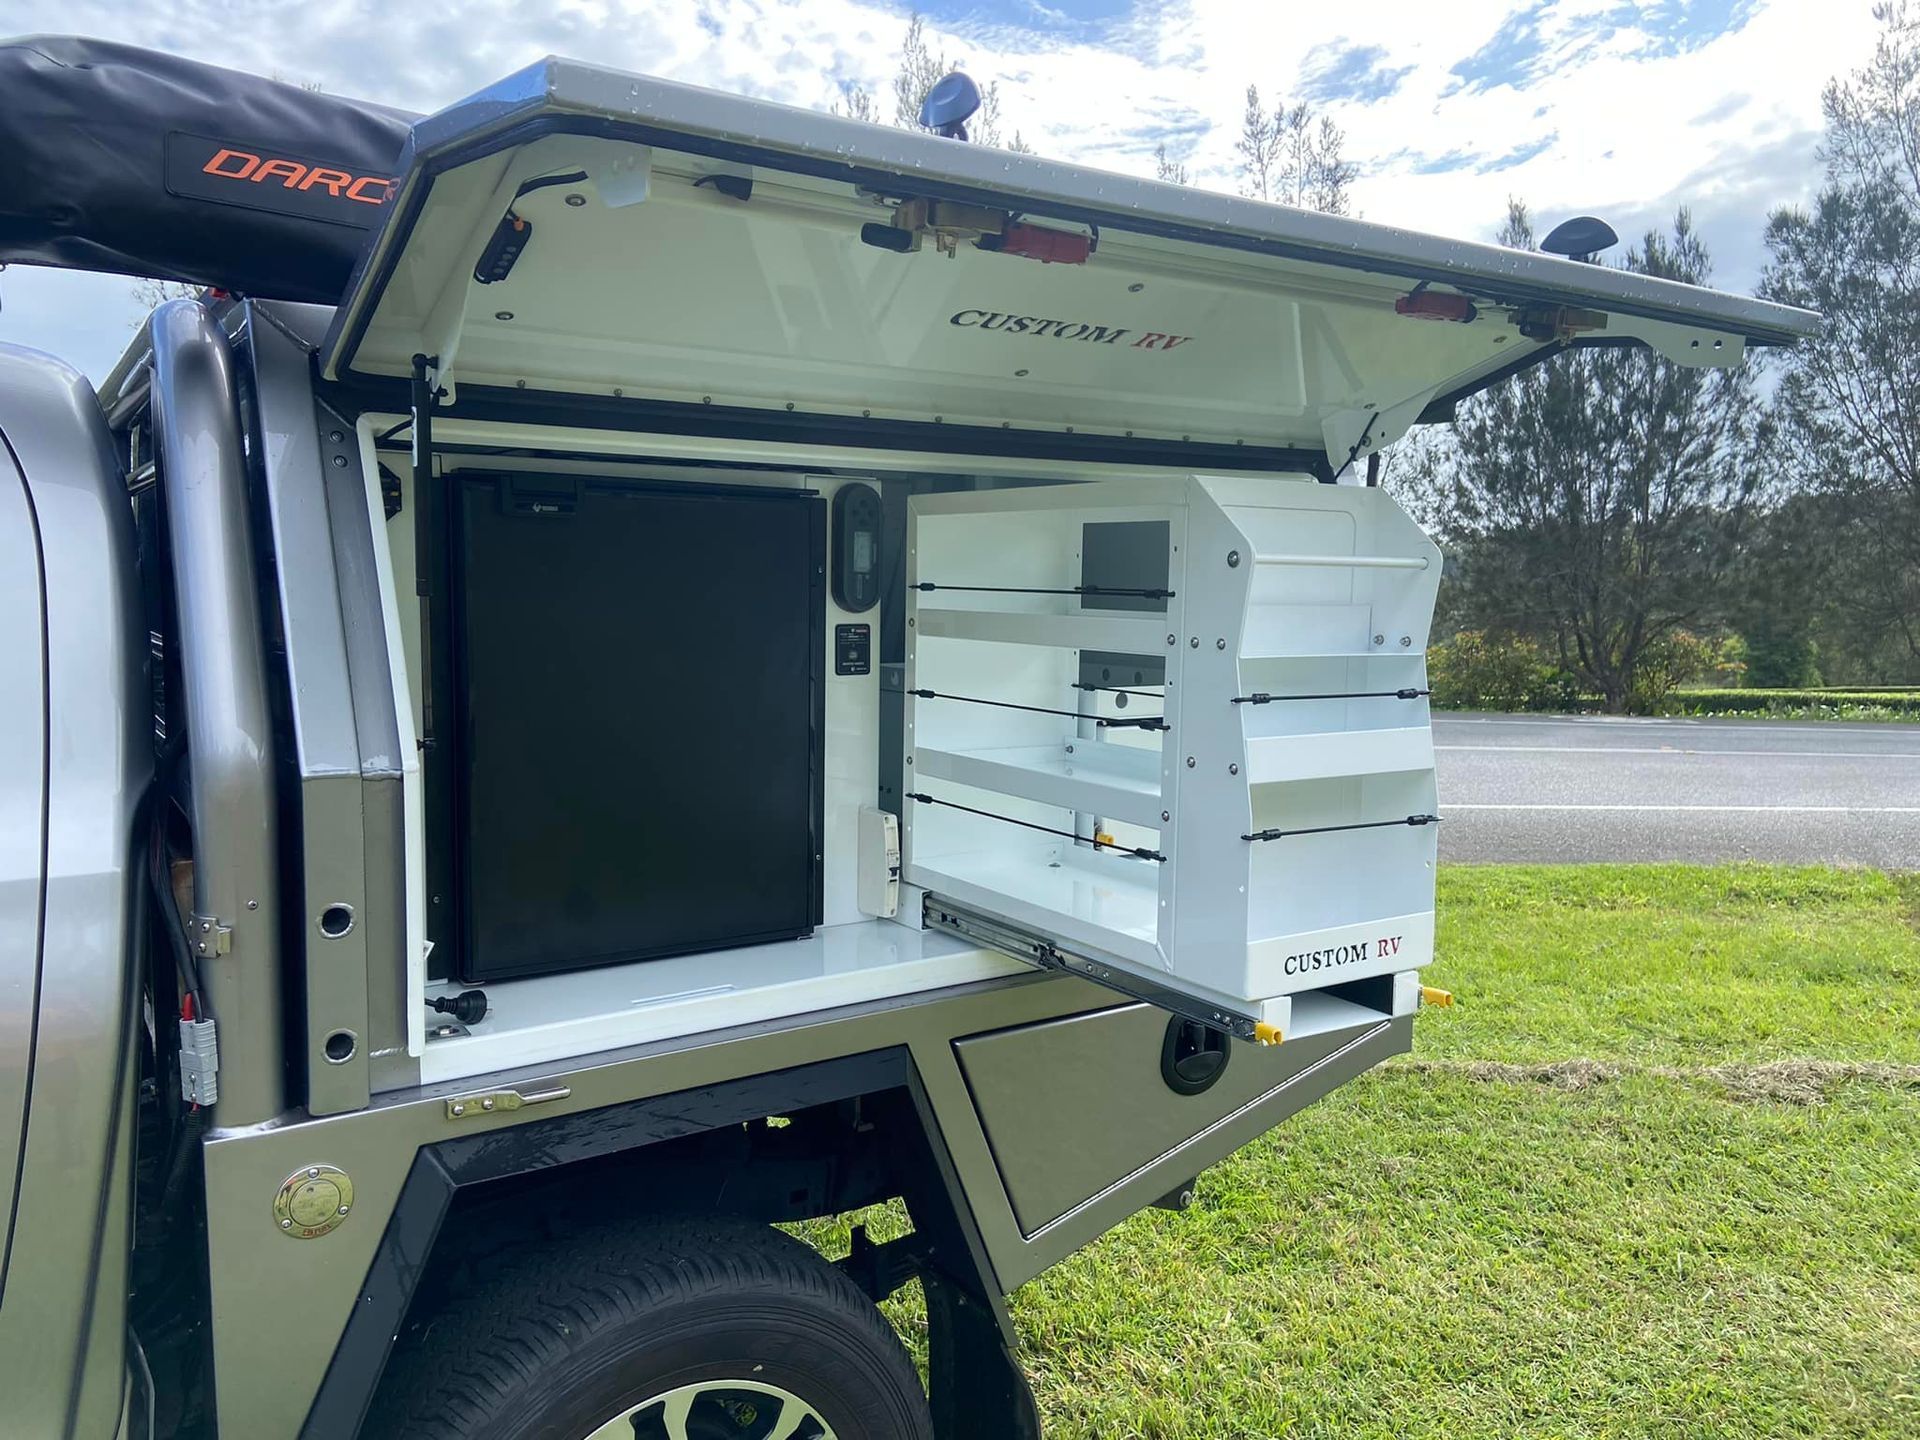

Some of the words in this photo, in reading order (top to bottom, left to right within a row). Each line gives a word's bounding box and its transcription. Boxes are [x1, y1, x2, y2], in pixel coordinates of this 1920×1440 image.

[949, 309, 1132, 344] CUSTOM
[1130, 332, 1196, 350] RV
[1284, 942, 1368, 975] CUSTOM
[1377, 936, 1403, 957] RV
